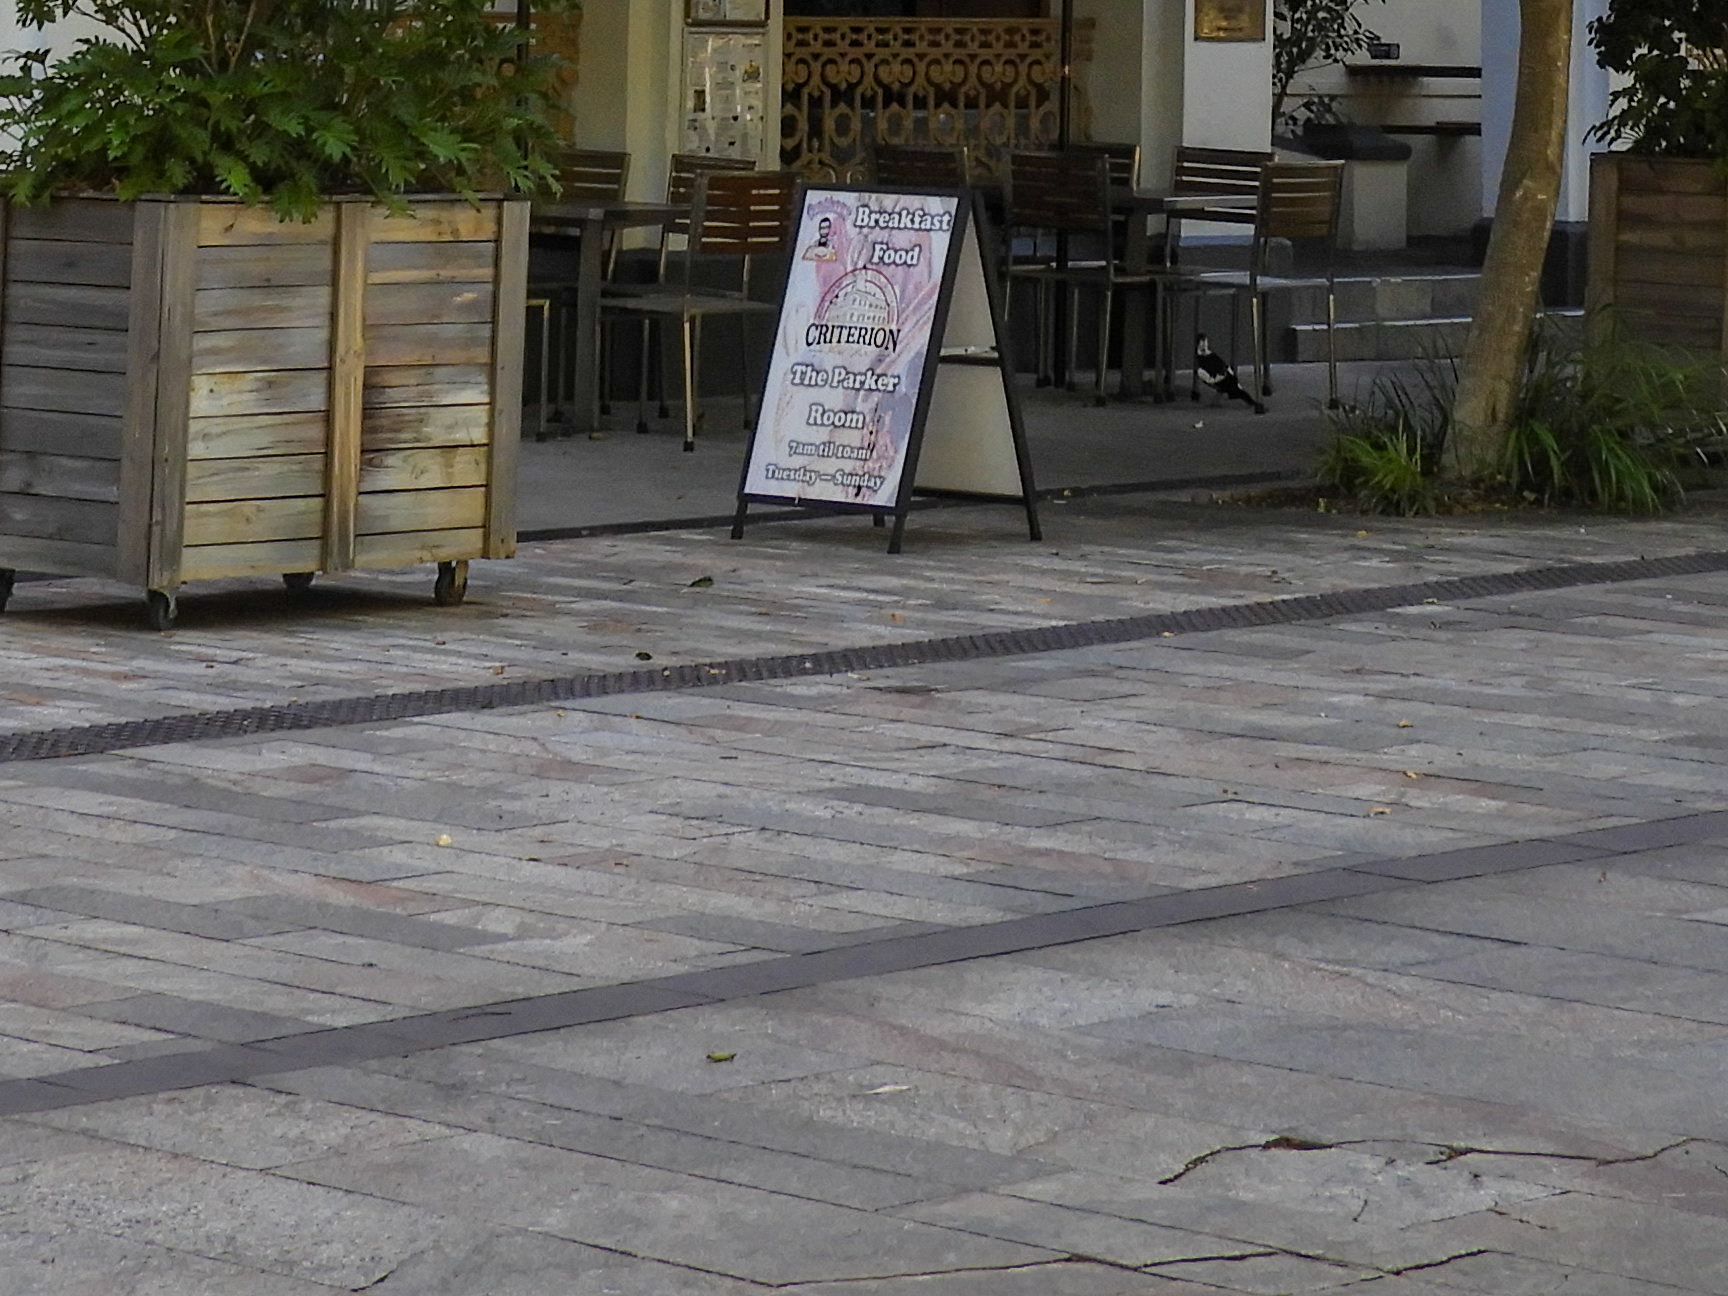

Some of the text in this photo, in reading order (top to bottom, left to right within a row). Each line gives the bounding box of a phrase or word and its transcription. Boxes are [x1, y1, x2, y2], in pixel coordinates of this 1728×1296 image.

[854, 204, 953, 232] Breakfast
[871, 242, 921, 267] Food
[805, 322, 901, 353] CRITERION
[791, 362, 900, 393] The Parker
[806, 402, 866, 430] Room
[788, 440, 872, 461] 7am til 10am
[765, 463, 819, 486] Tuesday
[833, 469, 885, 491] Sunday
